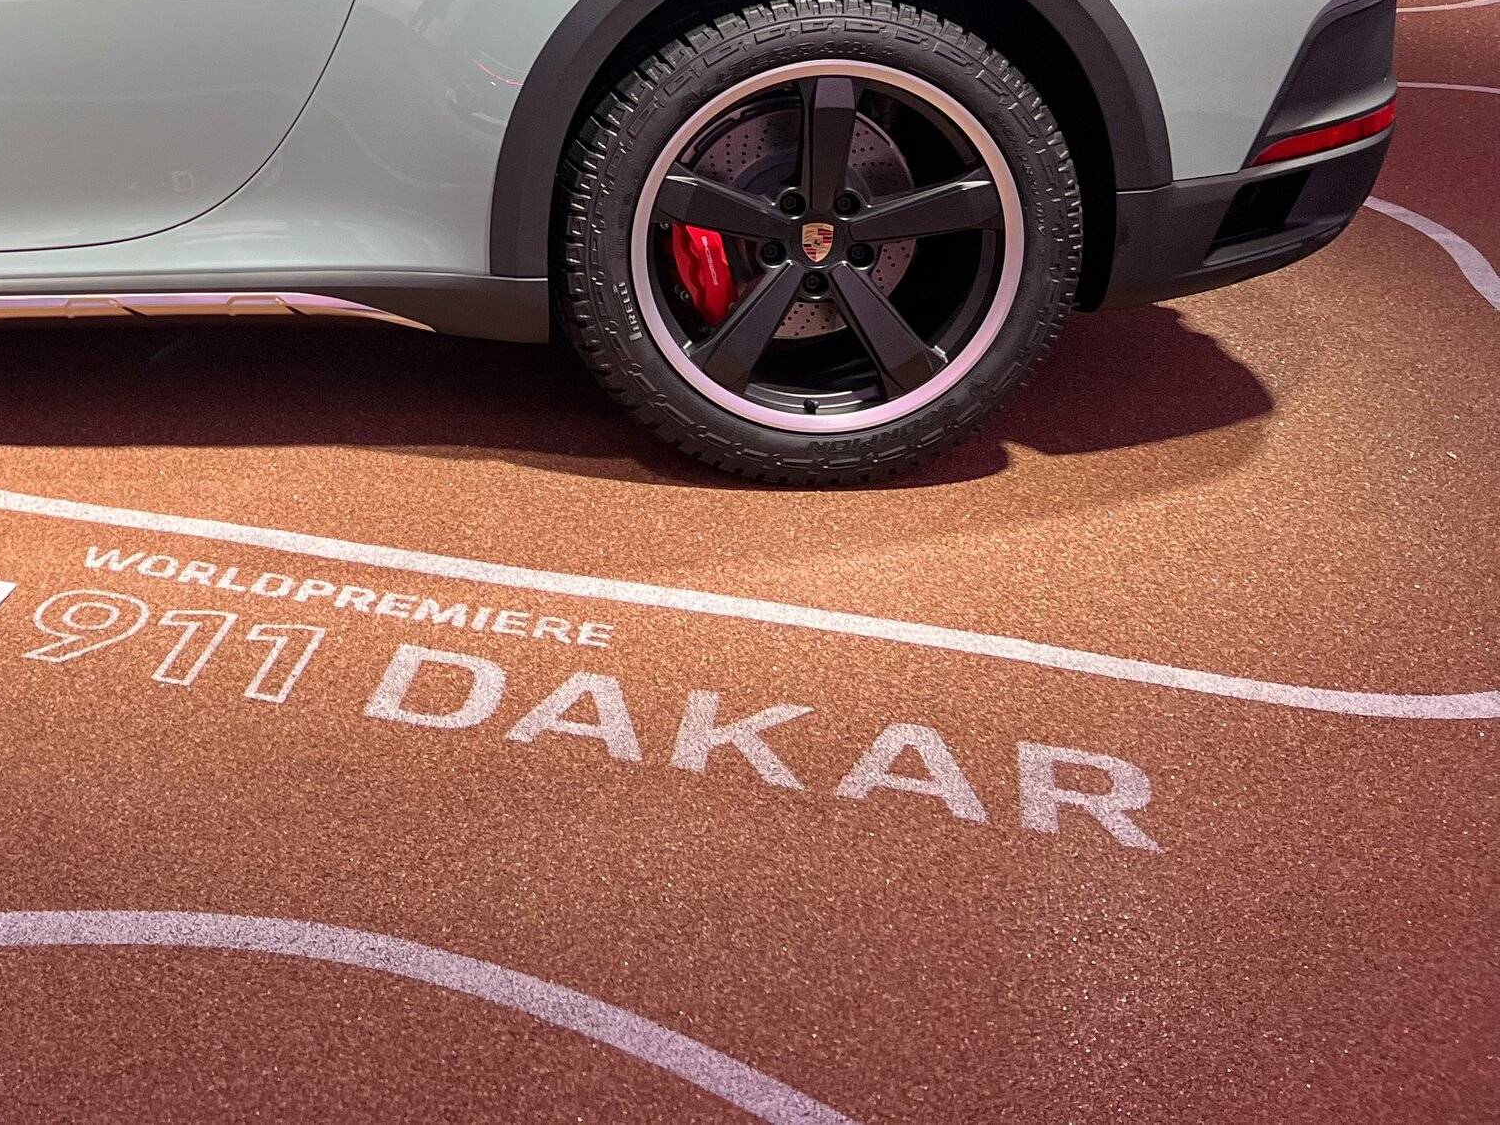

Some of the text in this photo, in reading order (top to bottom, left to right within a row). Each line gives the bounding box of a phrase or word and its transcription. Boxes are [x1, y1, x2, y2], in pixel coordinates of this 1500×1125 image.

[83, 545, 614, 649] WORLDPREMIERE
[22, 588, 1164, 854] 911 DAKAR
